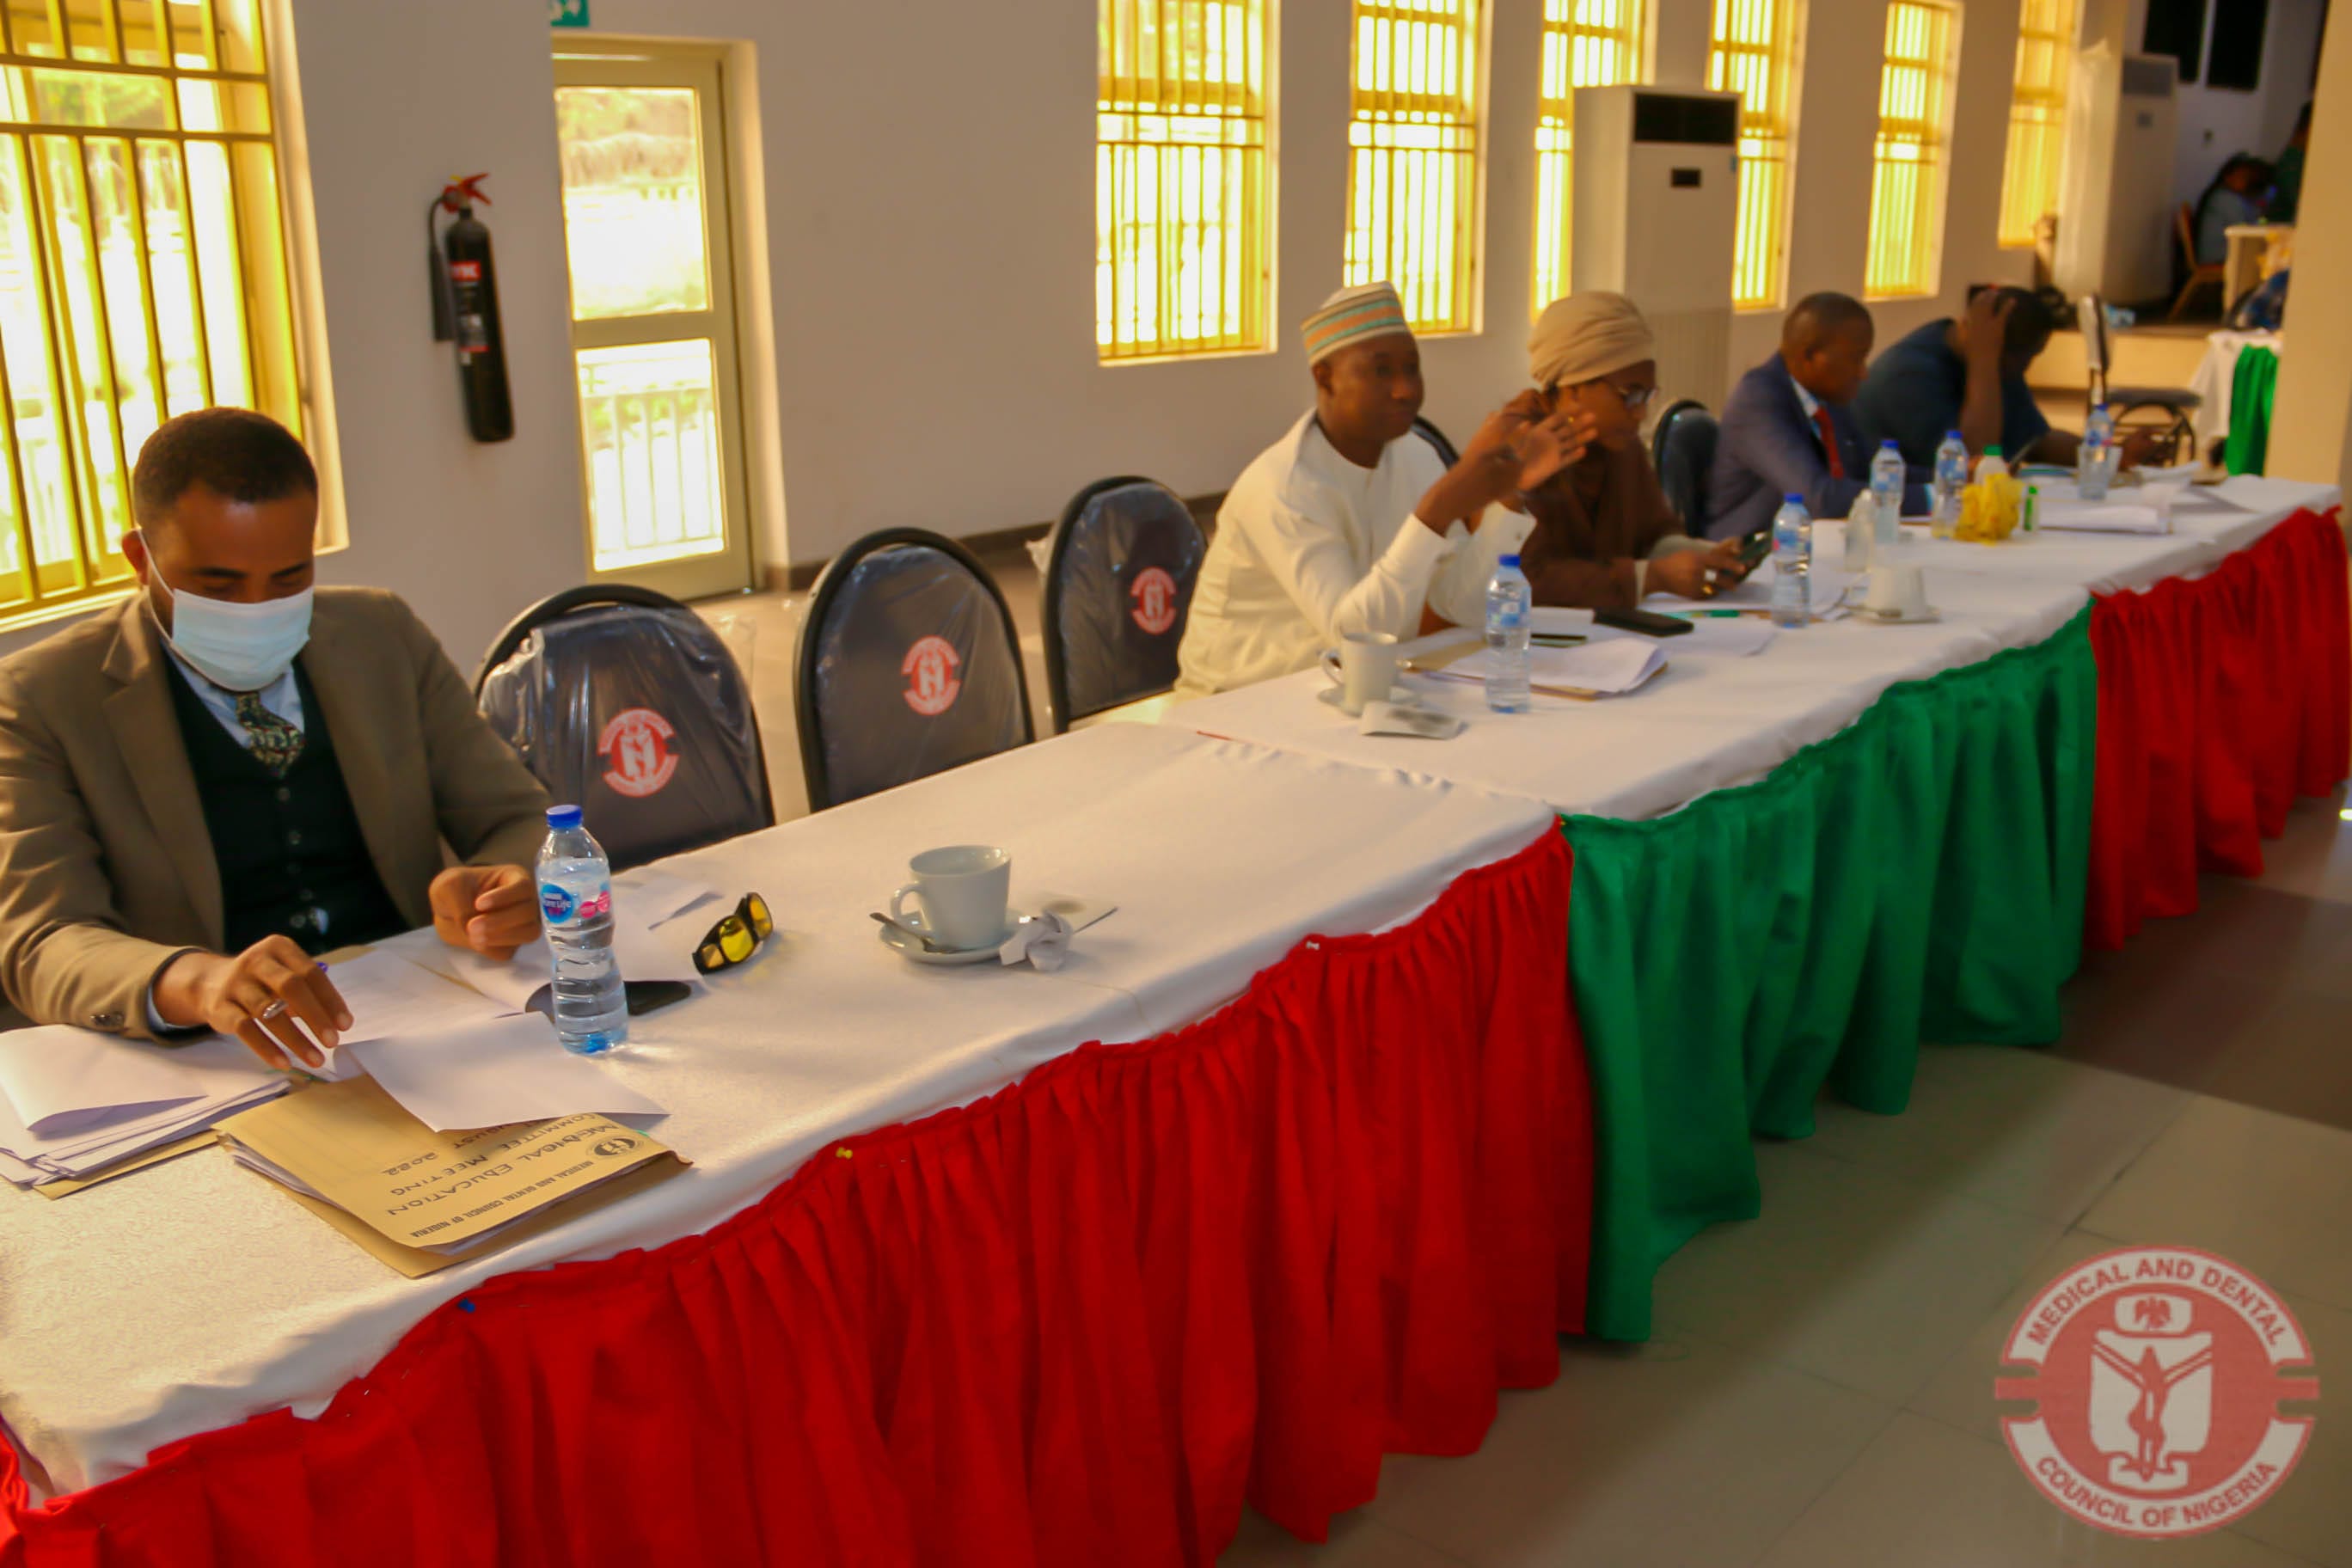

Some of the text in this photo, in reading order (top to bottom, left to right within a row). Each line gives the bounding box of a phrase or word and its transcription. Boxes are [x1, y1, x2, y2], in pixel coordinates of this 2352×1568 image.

[501, 1112, 596, 1150] COMMITTEE
[516, 1124, 619, 1161] MEDICAL
[387, 1163, 513, 1216] EDUCATION
[390, 1155, 489, 1196] MEETING
[451, 1216, 465, 1224] OF
[462, 1199, 505, 1218] COUNCIL
[409, 1221, 451, 1238] NIGERIA
